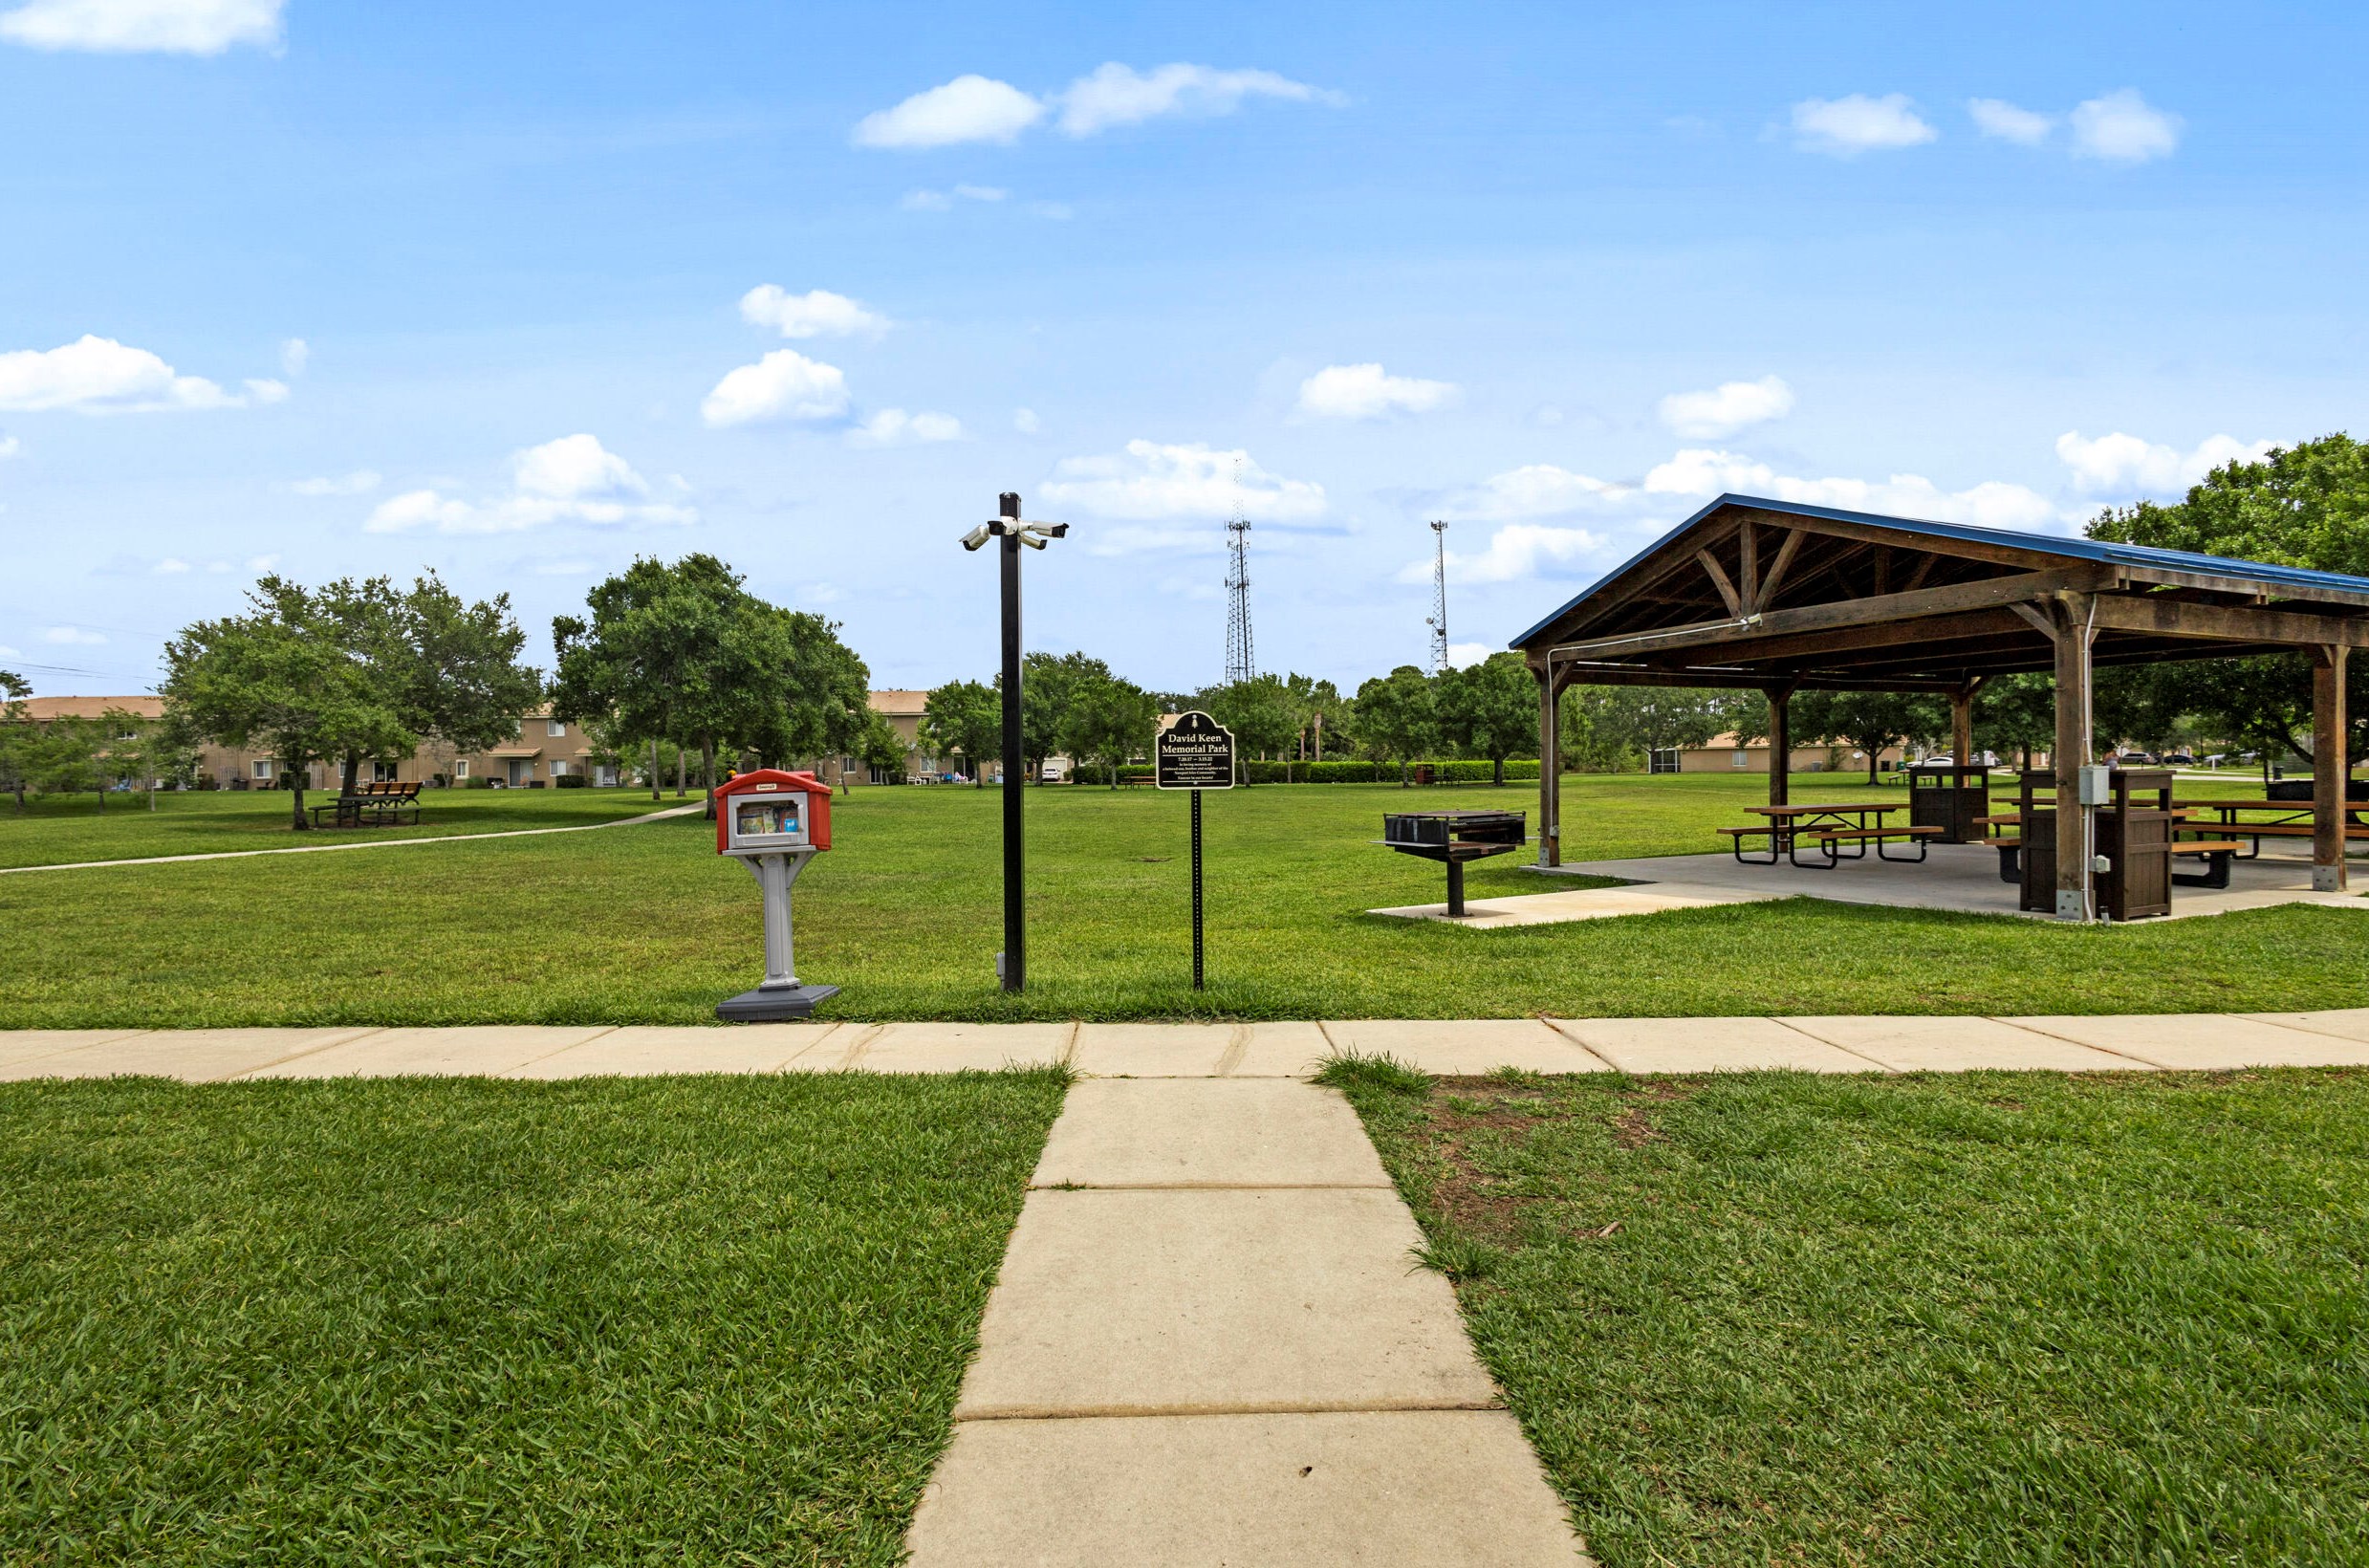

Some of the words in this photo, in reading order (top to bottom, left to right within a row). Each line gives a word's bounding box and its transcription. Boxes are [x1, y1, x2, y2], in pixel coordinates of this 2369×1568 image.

[1168, 733, 1196, 742] David
[1198, 733, 1222, 742] Keen
[1162, 744, 1206, 753] Memorial
[1207, 744, 1228, 753] Park
